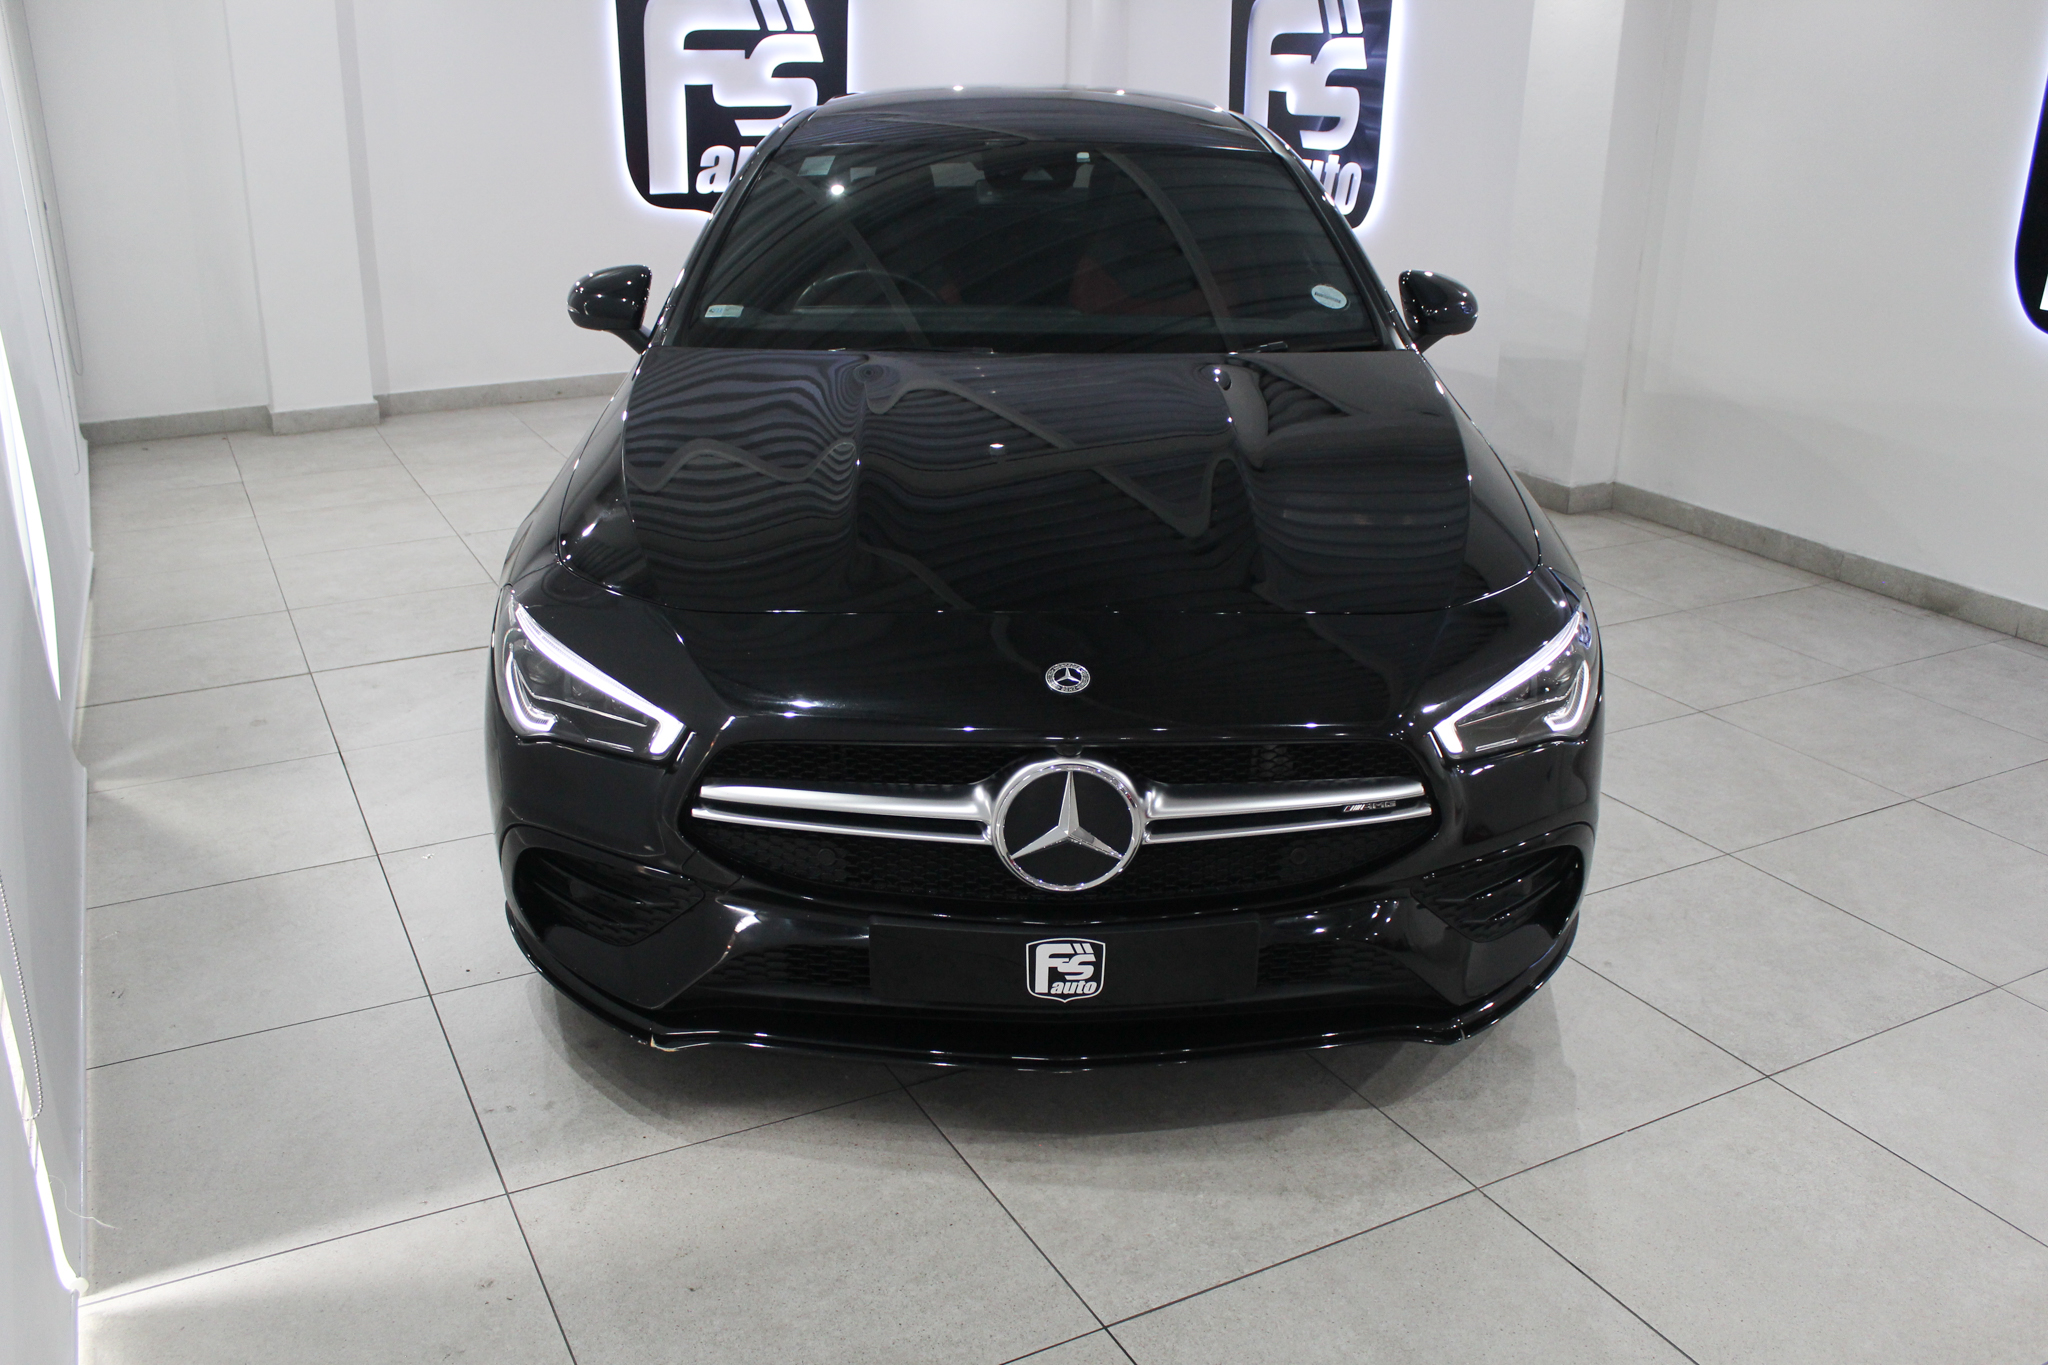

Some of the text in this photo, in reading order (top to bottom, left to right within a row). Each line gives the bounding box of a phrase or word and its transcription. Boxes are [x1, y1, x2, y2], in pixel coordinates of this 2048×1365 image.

[643, 0, 824, 194] FS
[1244, 0, 1367, 151] FS
[1035, 943, 1096, 993] FS
[1050, 980, 1097, 994] auto
